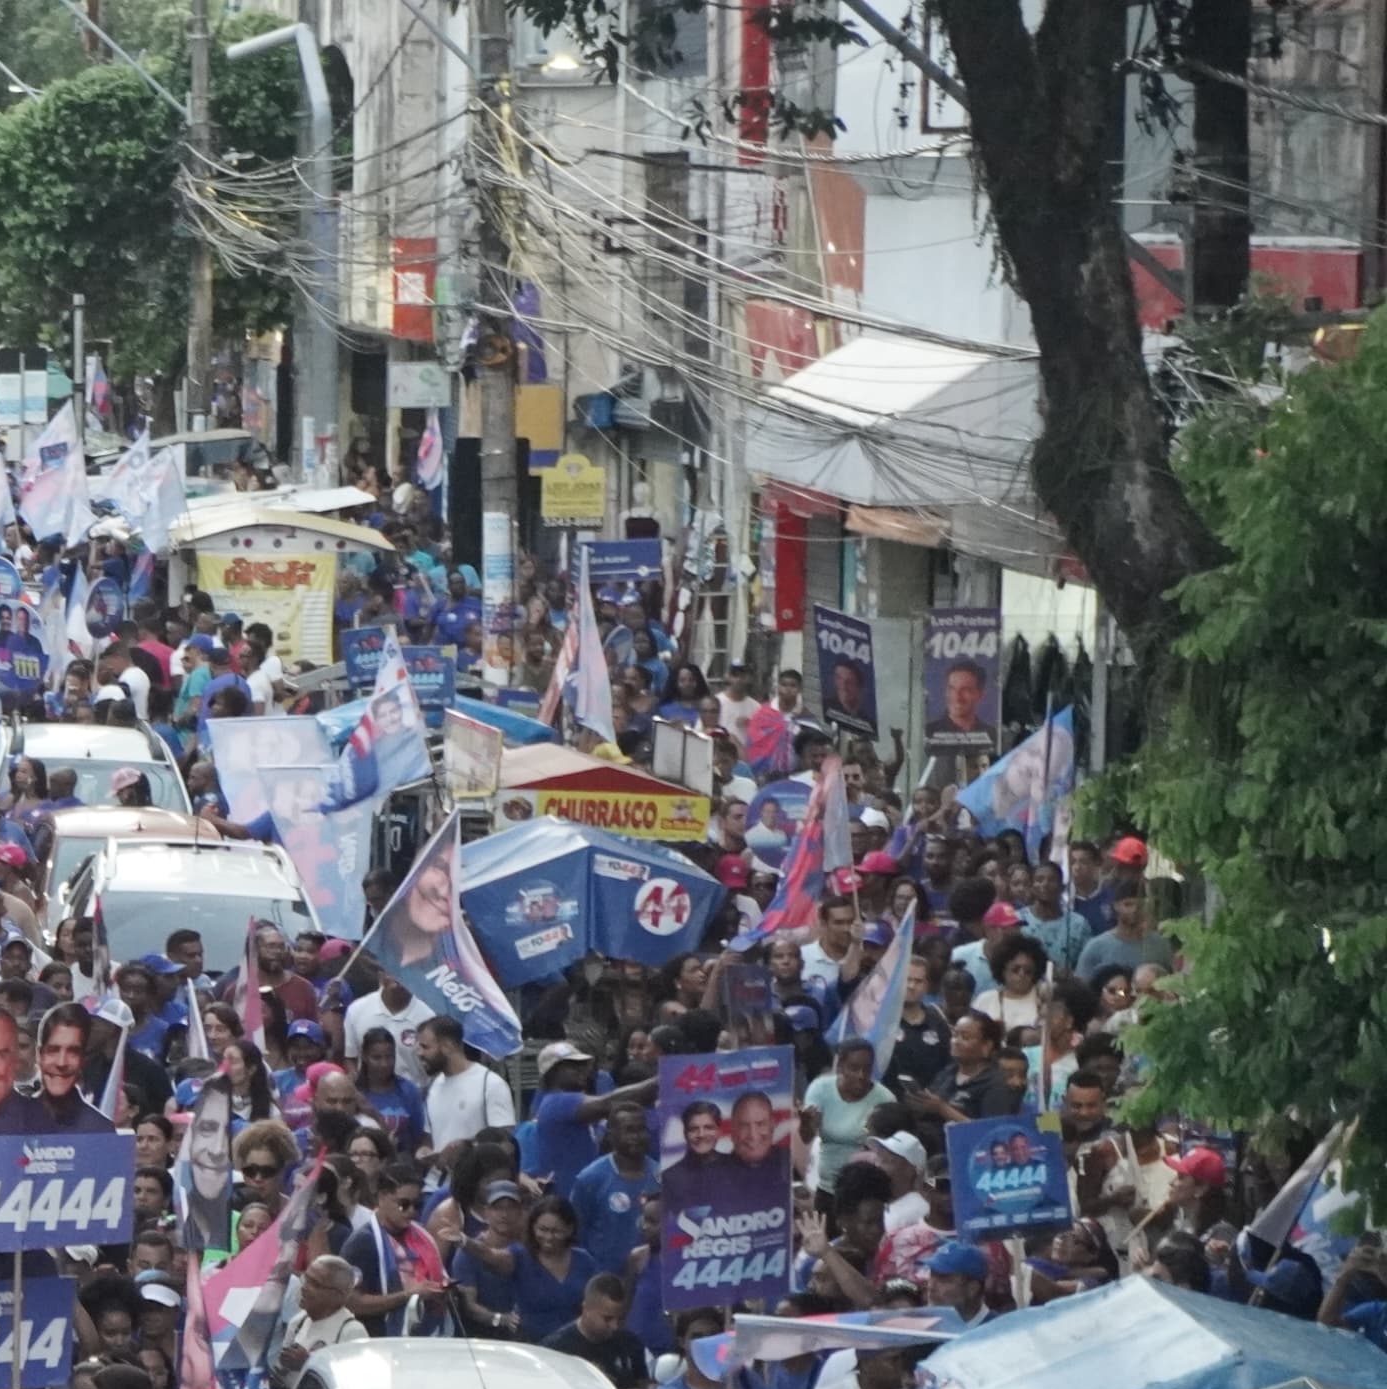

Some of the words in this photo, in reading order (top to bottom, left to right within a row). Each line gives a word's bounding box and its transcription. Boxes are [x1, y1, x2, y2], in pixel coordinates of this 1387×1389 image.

[817, 629, 871, 664] 1044
[929, 631, 998, 659] 1044
[544, 797, 659, 830] CHURRASCO
[636, 884, 689, 929] 44
[425, 963, 486, 1014] Neto
[673, 1063, 717, 1094] 44
[974, 1164, 1049, 1194] 44444
[676, 1206, 786, 1241] SANDRO
[672, 1249, 788, 1291] 44444
